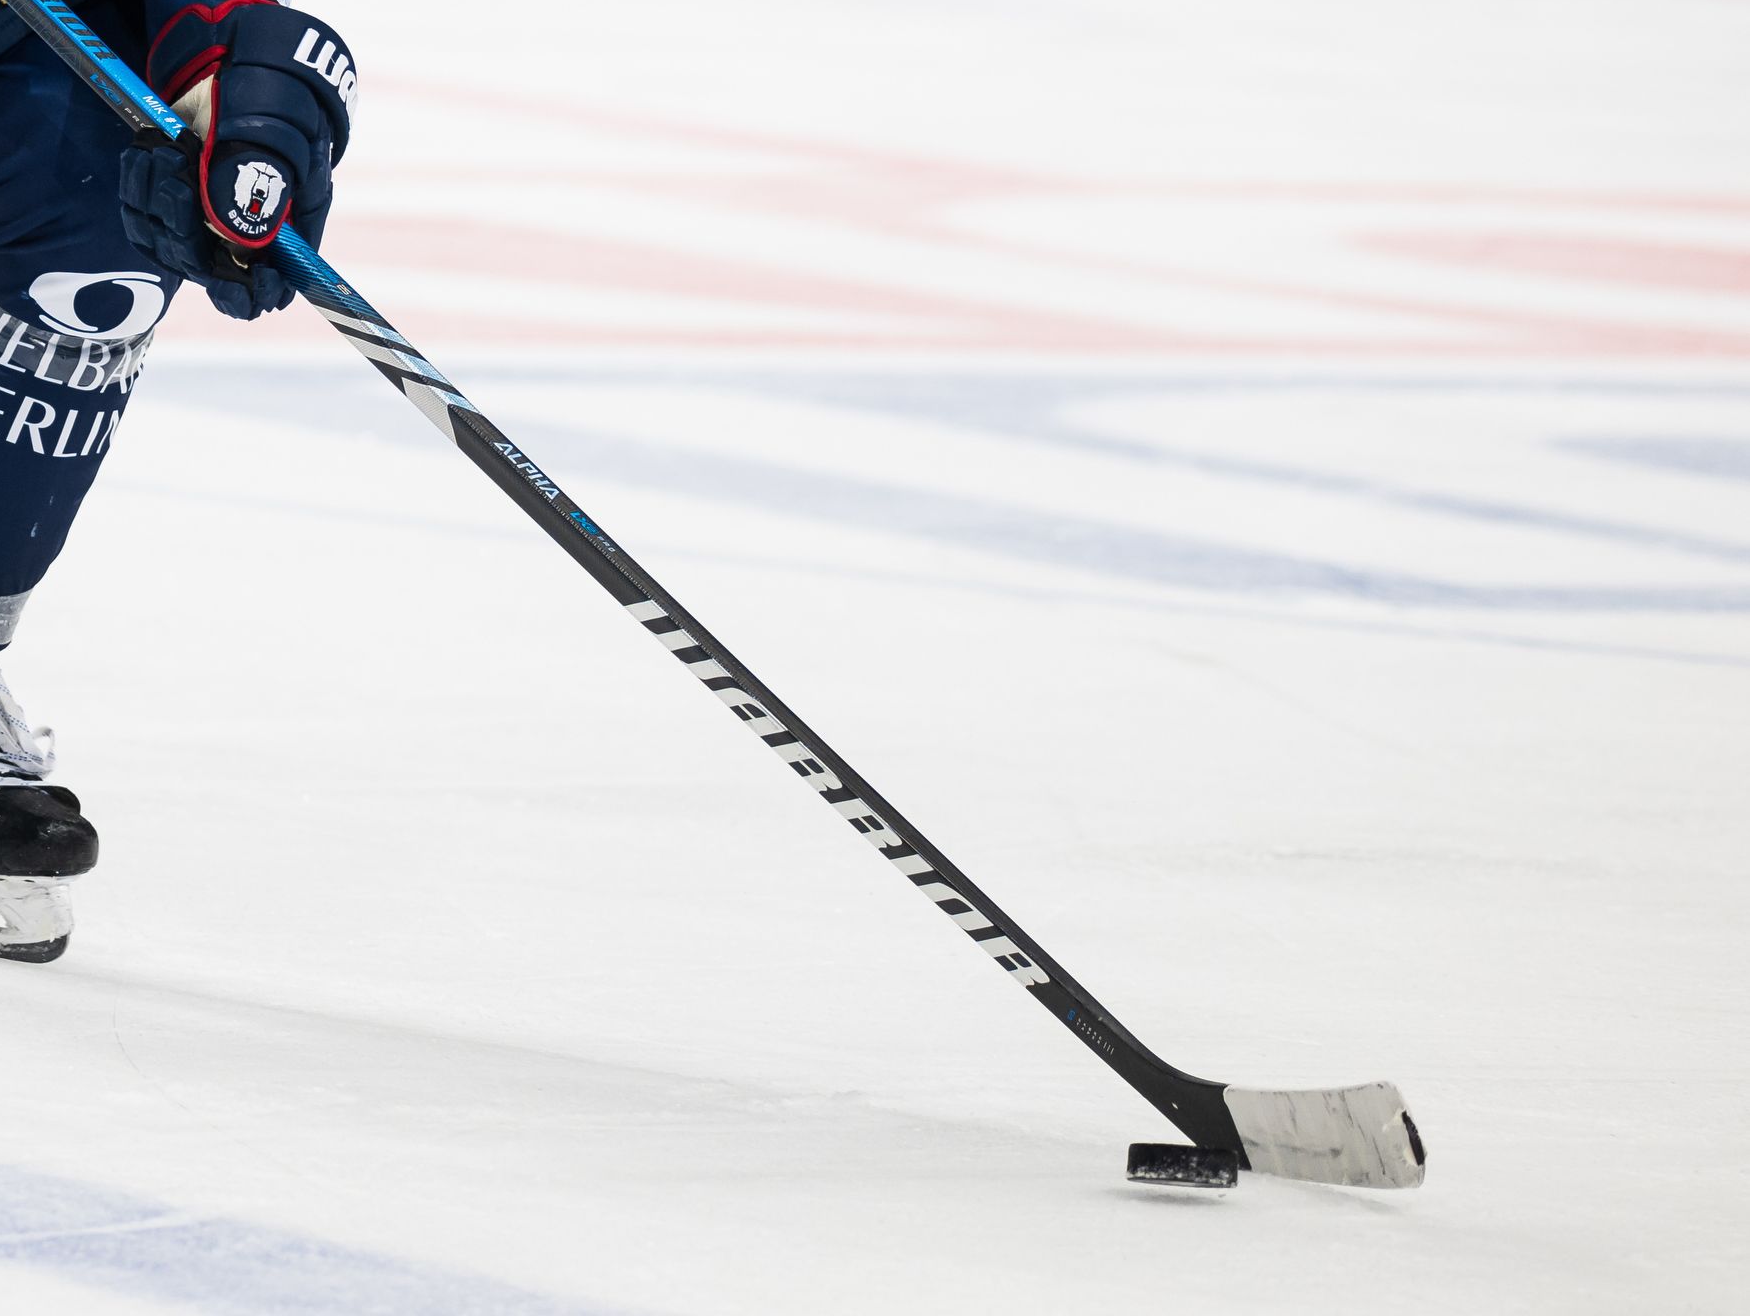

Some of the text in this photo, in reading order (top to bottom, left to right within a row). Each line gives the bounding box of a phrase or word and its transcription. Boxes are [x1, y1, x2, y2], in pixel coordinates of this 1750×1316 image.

[143, 96, 168, 115] MIK
[228, 209, 268, 235] BERLIN
[493, 442, 560, 500] ALPHA
[625, 601, 1051, 988] WARRIOR
